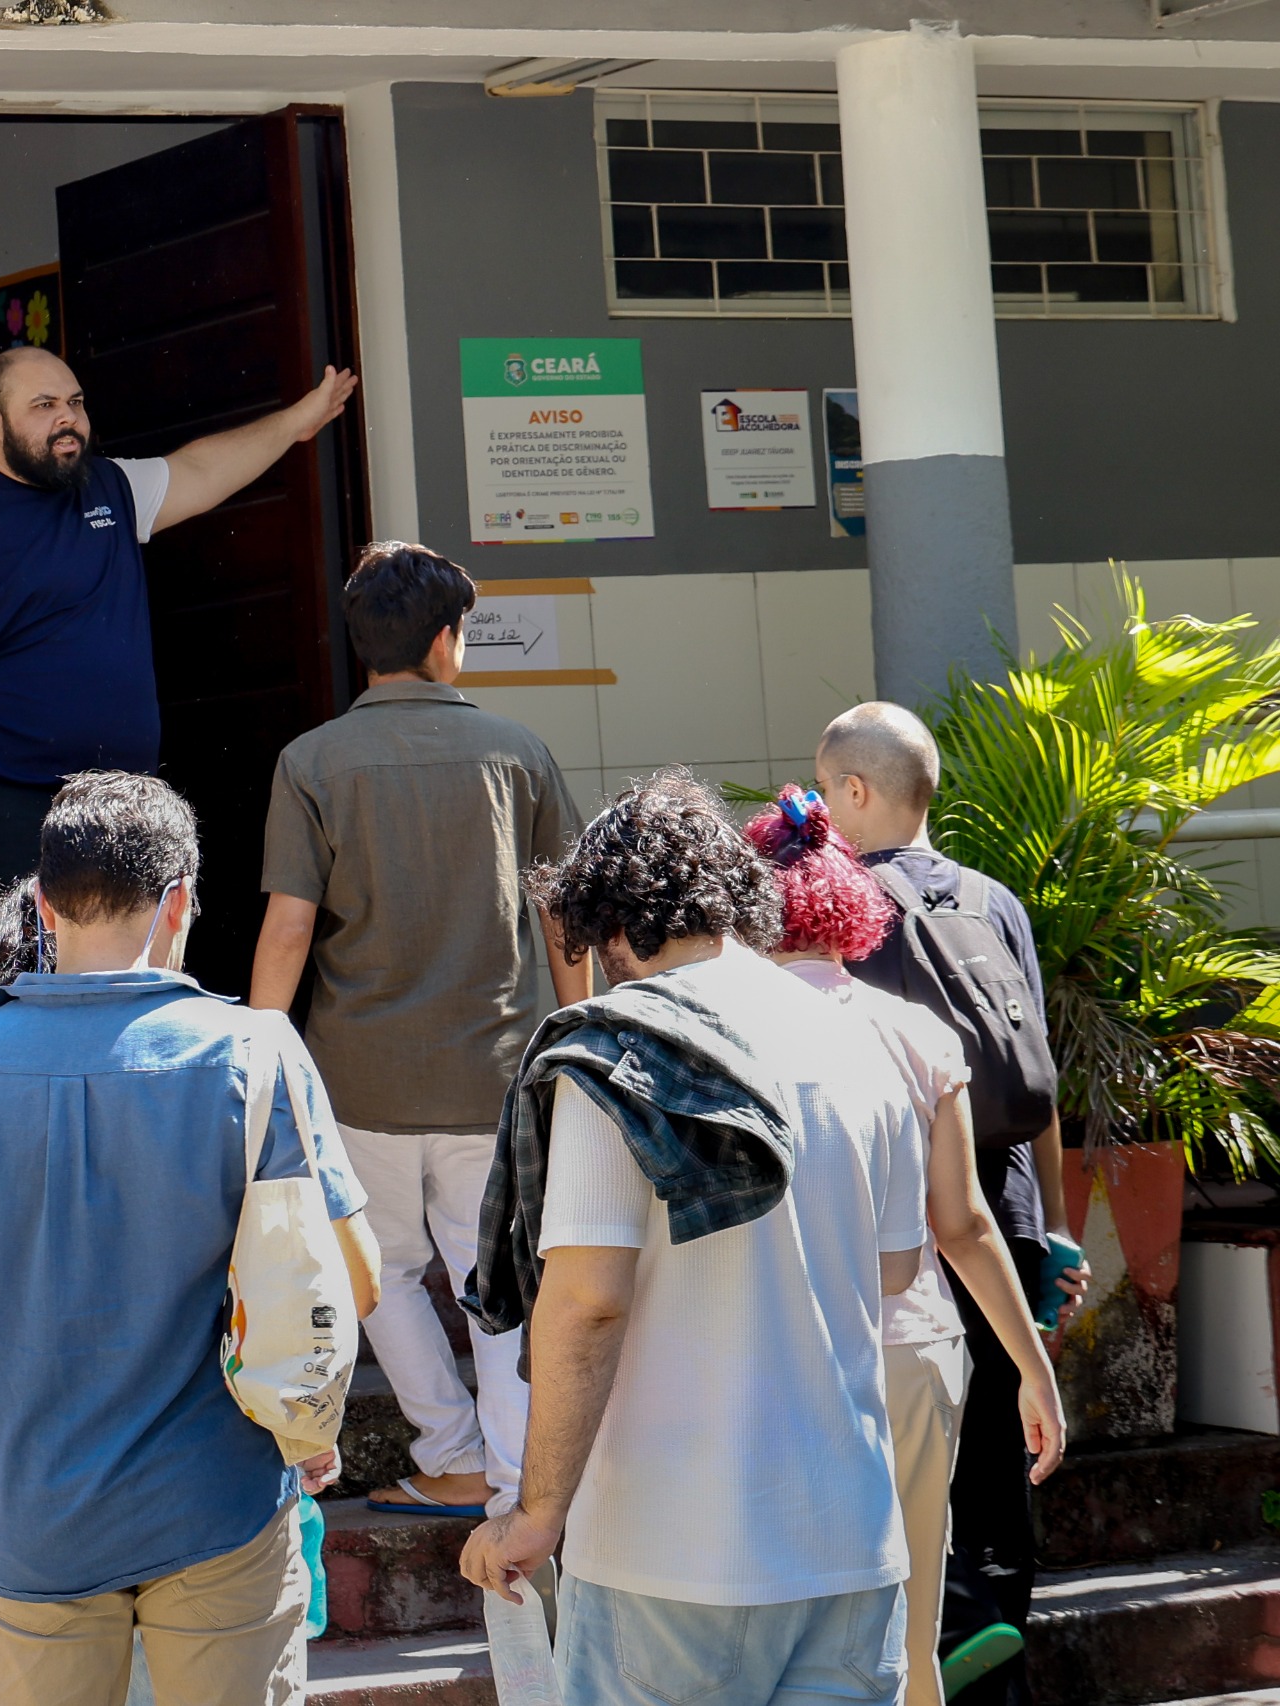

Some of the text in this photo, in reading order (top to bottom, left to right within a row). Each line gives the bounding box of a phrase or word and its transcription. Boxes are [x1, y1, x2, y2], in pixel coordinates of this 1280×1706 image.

[530, 352, 601, 374] CEARÁ
[528, 409, 584, 424] AVISO
[739, 414, 777, 423] ESCOLA
[738, 423, 800, 432] ACOLHEDORA
[489, 430, 623, 440] É EXPRESSAMENTE PROIBIDA
[487, 440, 627, 454] A PRÁTICA DE DISCRIMINAÇÃO
[490, 454, 626, 467] POR ORIENTAÇÃO SEXUAL OU
[501, 466, 616, 478] IDENTIDADE DE GÊNERO.
[484, 510, 512, 523] CEARÁ
[498, 629, 521, 641] 12
